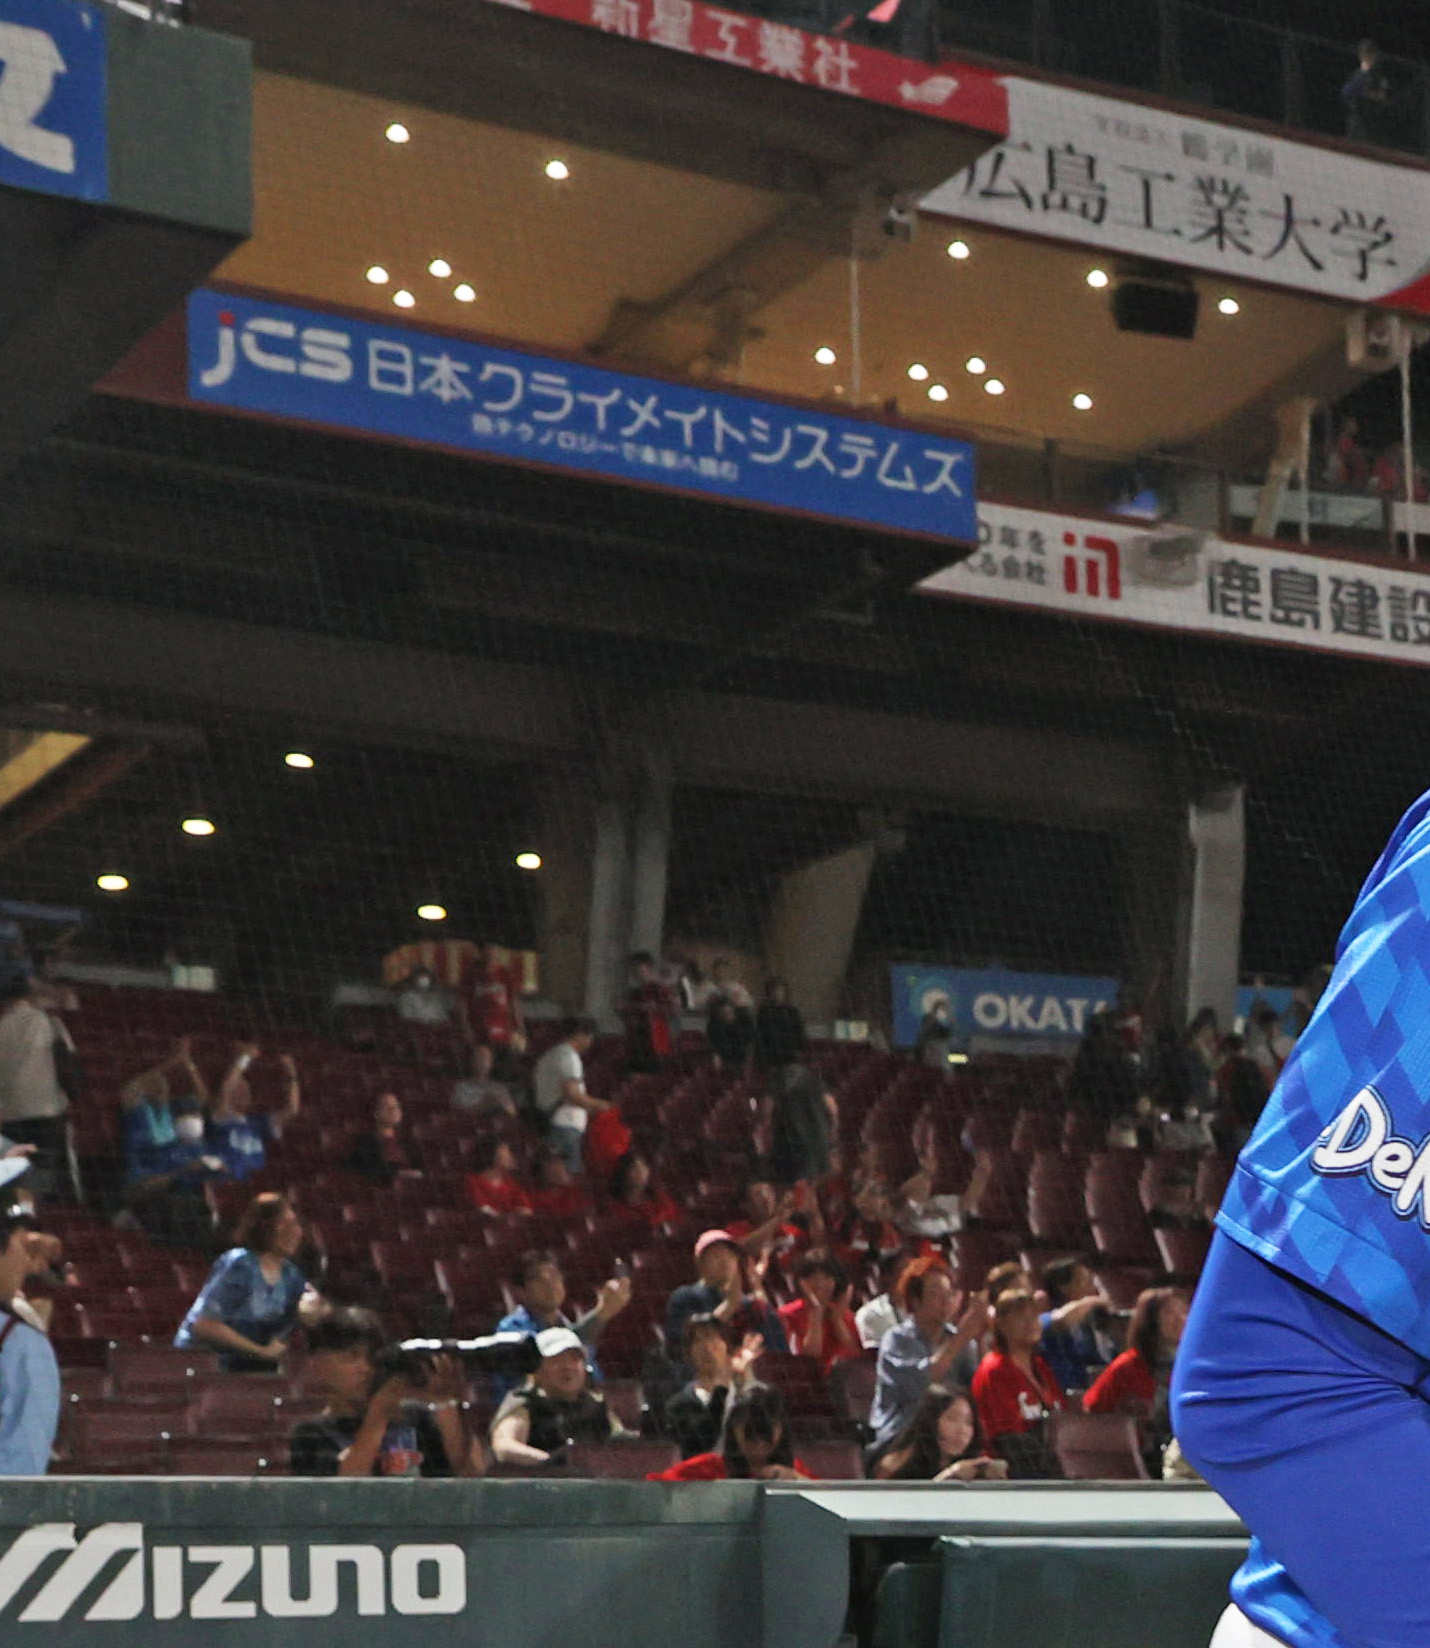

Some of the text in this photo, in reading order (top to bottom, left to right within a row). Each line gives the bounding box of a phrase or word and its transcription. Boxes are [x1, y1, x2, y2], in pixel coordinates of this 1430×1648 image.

[367, 337, 963, 498] 日本クライメイトシステムズ
[973, 991, 1108, 1033] OKAT
[0, 1521, 467, 1622] MIZUNO
